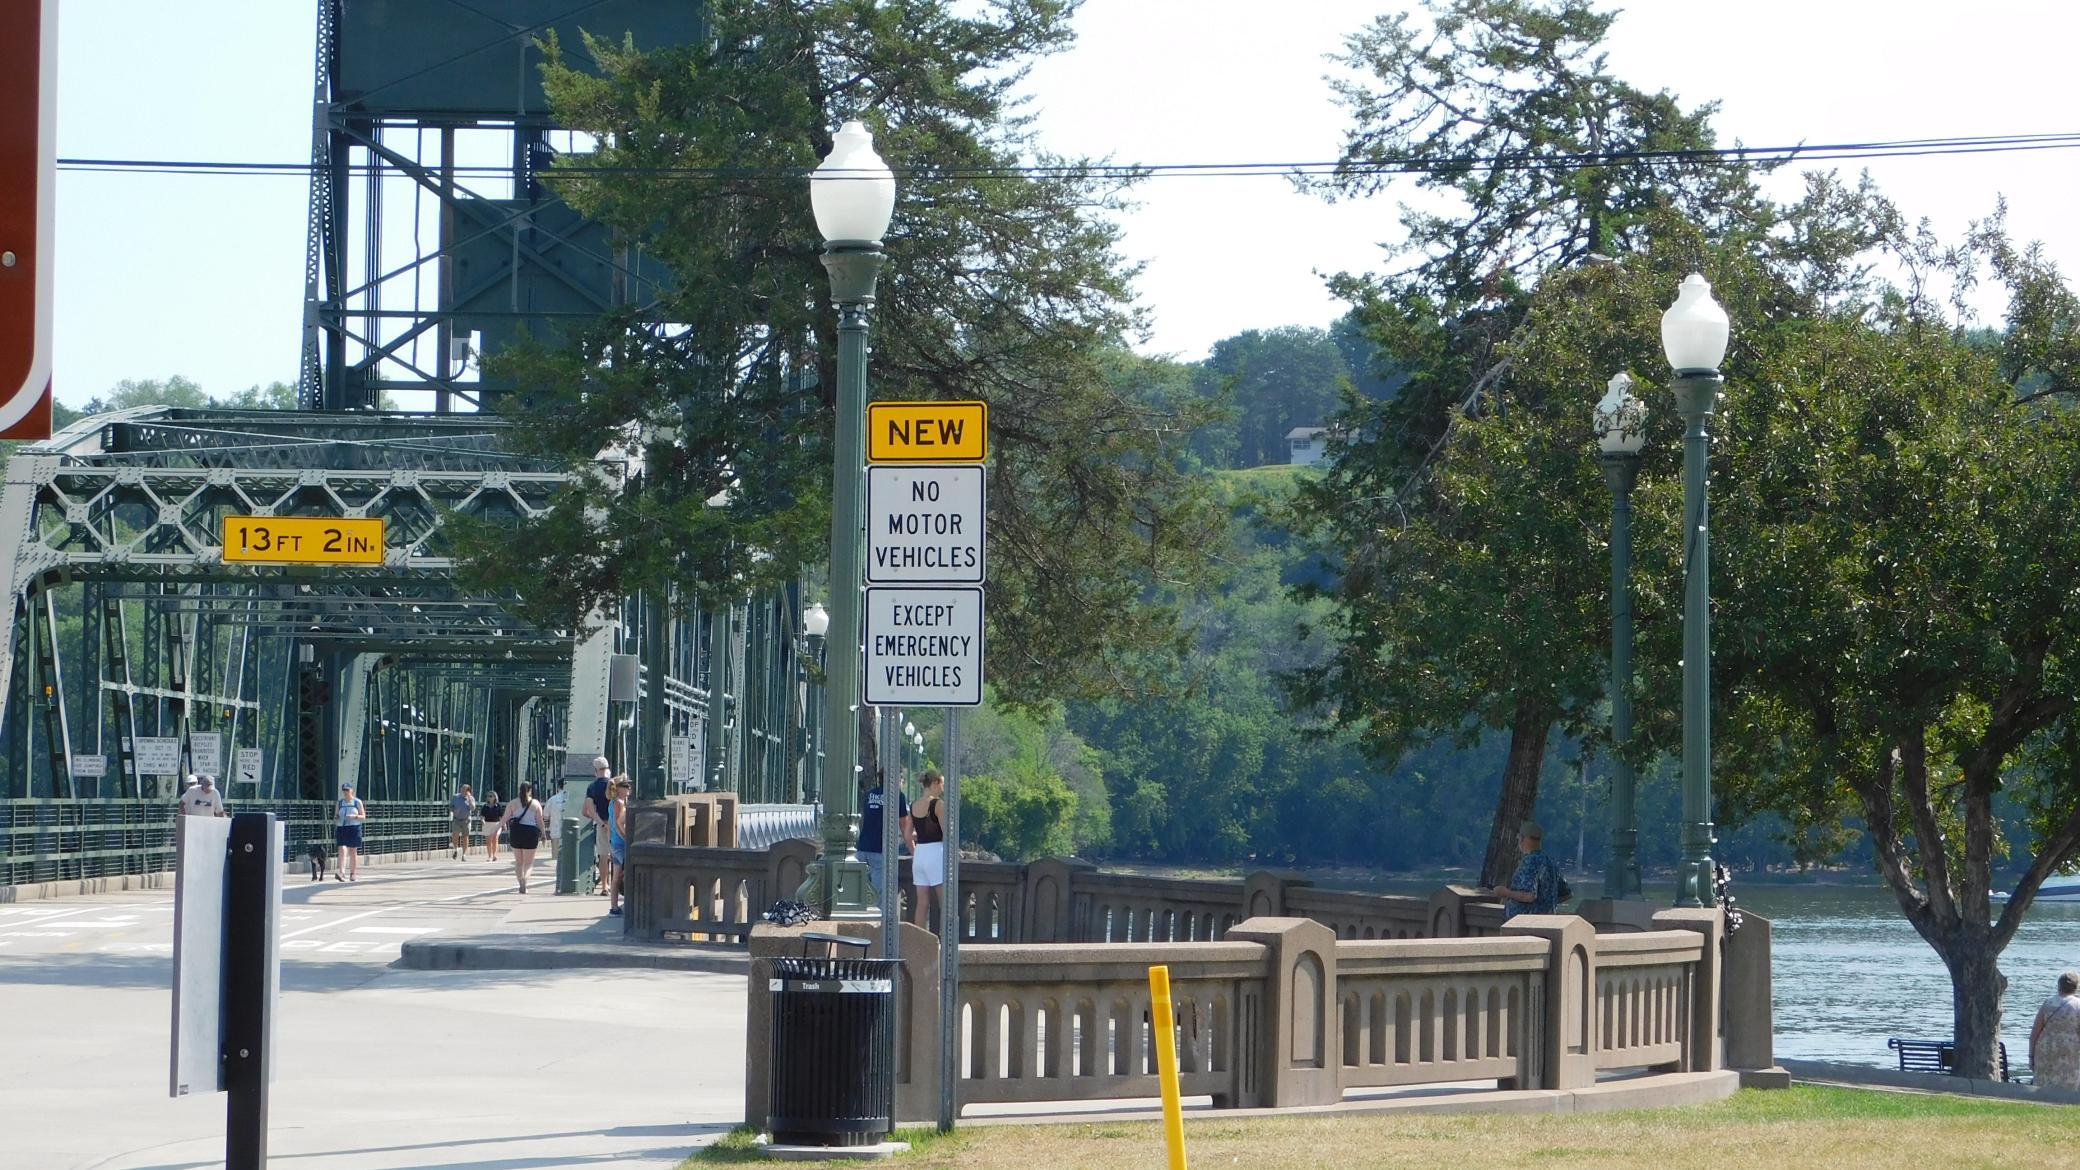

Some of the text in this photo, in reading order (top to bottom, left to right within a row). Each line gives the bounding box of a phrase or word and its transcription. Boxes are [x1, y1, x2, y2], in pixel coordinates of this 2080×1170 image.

[888, 419, 965, 445] NEW
[912, 480, 940, 502] NO
[889, 513, 963, 535] MOTOR
[875, 546, 976, 568] VEHICLES
[893, 605, 954, 626] EXCEPT
[875, 635, 971, 657] EMERGENCY
[885, 666, 962, 687] VEHICLES
[801, 981, 820, 991] Trash
